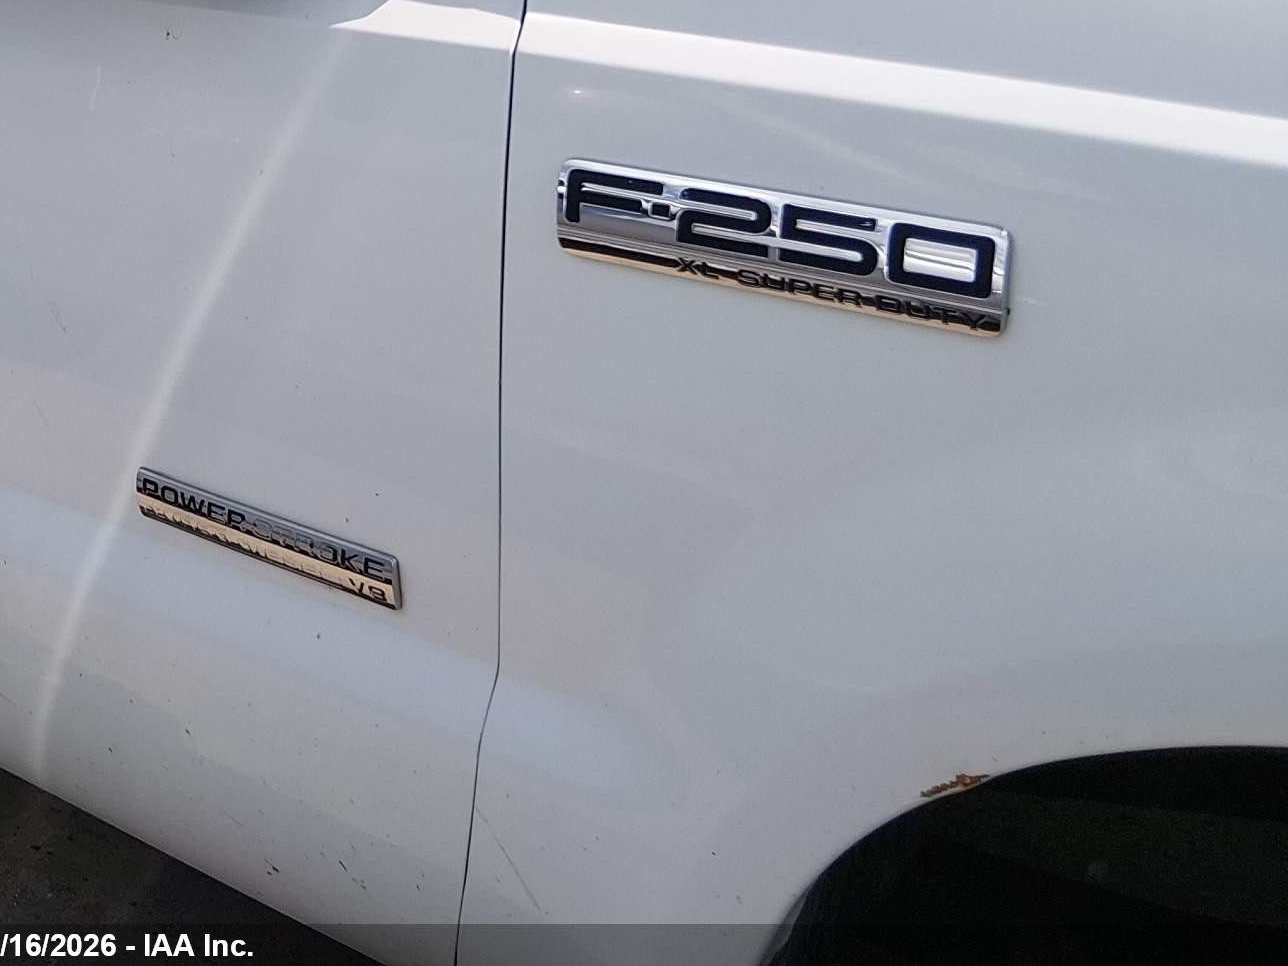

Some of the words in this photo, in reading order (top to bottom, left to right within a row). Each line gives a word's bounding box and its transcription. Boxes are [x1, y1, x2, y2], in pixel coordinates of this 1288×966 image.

[564, 168, 996, 299] F-250
[676, 257, 719, 280] XL
[736, 269, 862, 307] SUPER
[875, 293, 987, 331] DUTY
